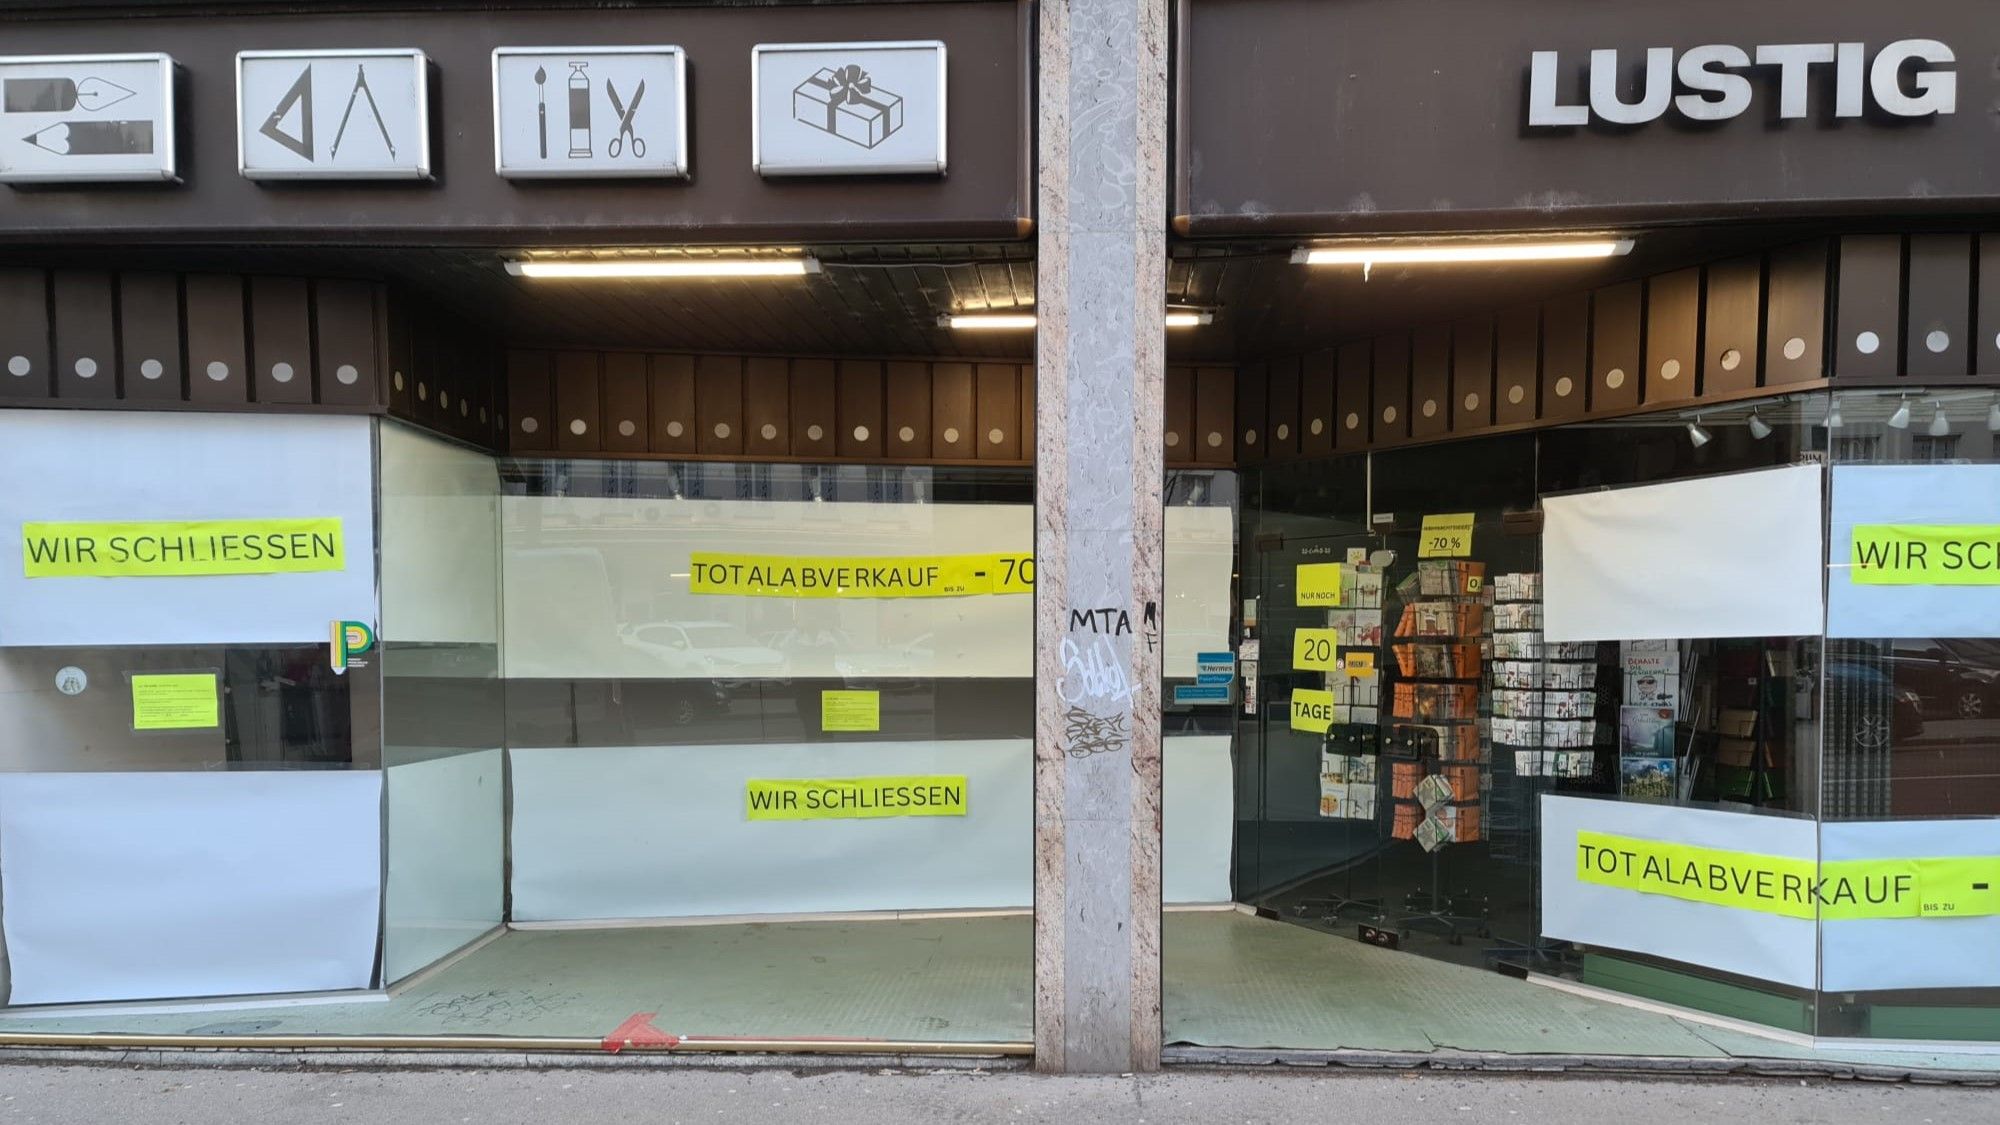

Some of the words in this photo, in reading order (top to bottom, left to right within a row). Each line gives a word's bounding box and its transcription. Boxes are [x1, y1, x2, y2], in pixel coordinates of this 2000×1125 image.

[1529, 39, 1957, 127] LUSTIG
[27, 537, 98, 563] WIR
[109, 533, 335, 563] SCHLIESSEN
[1428, 538, 1448, 549] -70
[1450, 536, 1461, 549] %
[1856, 541, 1927, 569] WIR
[1942, 541, 2000, 570] SC
[692, 562, 939, 588] TOTALABVERKAUF
[999, 558, 1034, 585] 70
[1301, 591, 1315, 600] NUR
[1316, 590, 1336, 600] NOCH
[1070, 607, 1133, 636] MTA
[1303, 638, 1331, 662] 20
[1294, 702, 1331, 720] TAGE
[749, 790, 797, 810] WIR
[806, 786, 960, 811] SCHLIESSEN
[1579, 844, 1912, 906] TOTALABVERKAUF
[1923, 903, 1939, 911] BIS
[1942, 903, 1955, 911] ZU
